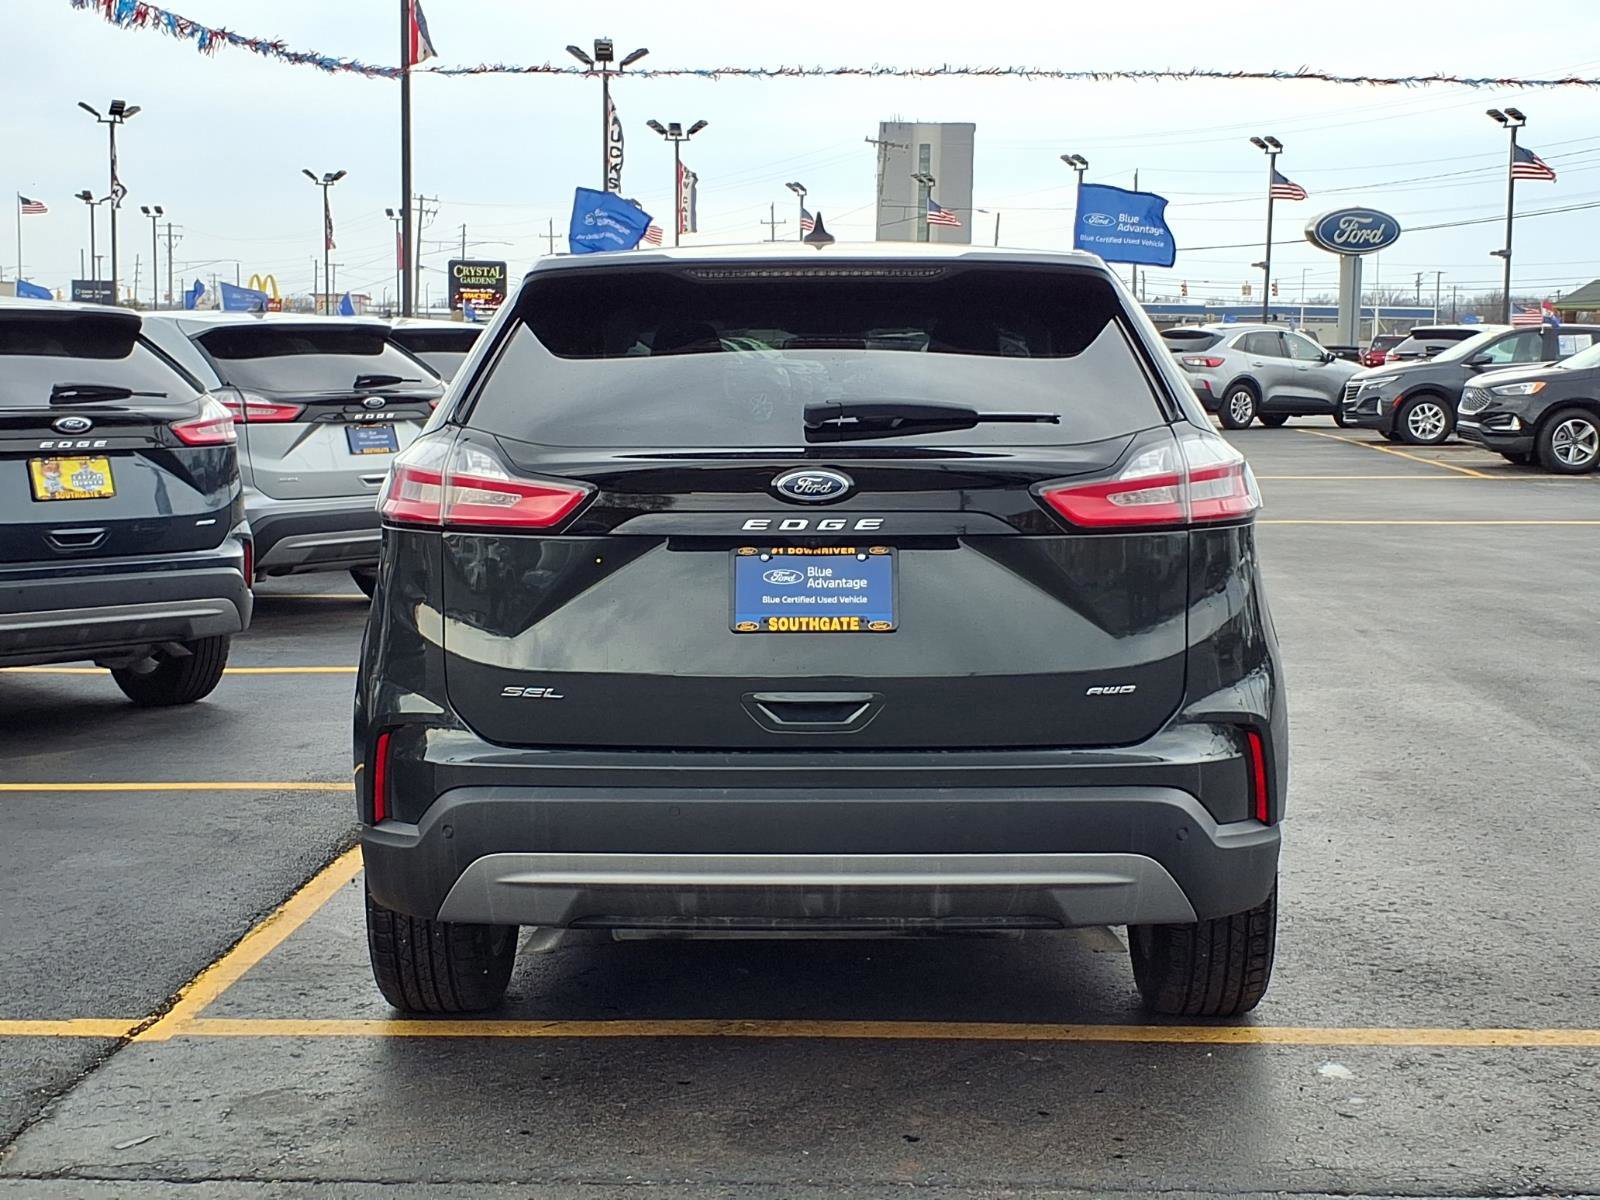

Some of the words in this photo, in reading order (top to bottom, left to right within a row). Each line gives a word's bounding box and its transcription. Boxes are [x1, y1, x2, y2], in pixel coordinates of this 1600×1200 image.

[1118, 213, 1140, 224] Blue
[1117, 224, 1164, 236] Advantage
[1334, 216, 1386, 244] Ford
[1095, 235, 1123, 244] Certified
[1123, 237, 1140, 245] Used
[1141, 238, 1165, 247] Vehicle
[454, 265, 504, 279] CRYSTAL
[40, 440, 107, 449] EDGE
[794, 477, 832, 494] Ford
[741, 518, 884, 531] EDGE
[787, 547, 856, 555] DOWNRIVER
[807, 566, 833, 577] Blue
[807, 578, 868, 590] Advantage
[762, 596, 780, 604] Blue
[781, 595, 815, 604] Certified
[816, 596, 838, 604] Used
[839, 596, 868, 604] Vehicle
[768, 617, 860, 631] SOUTHGATE
[501, 687, 564, 699] SEL
[1086, 685, 1136, 696] AWD
